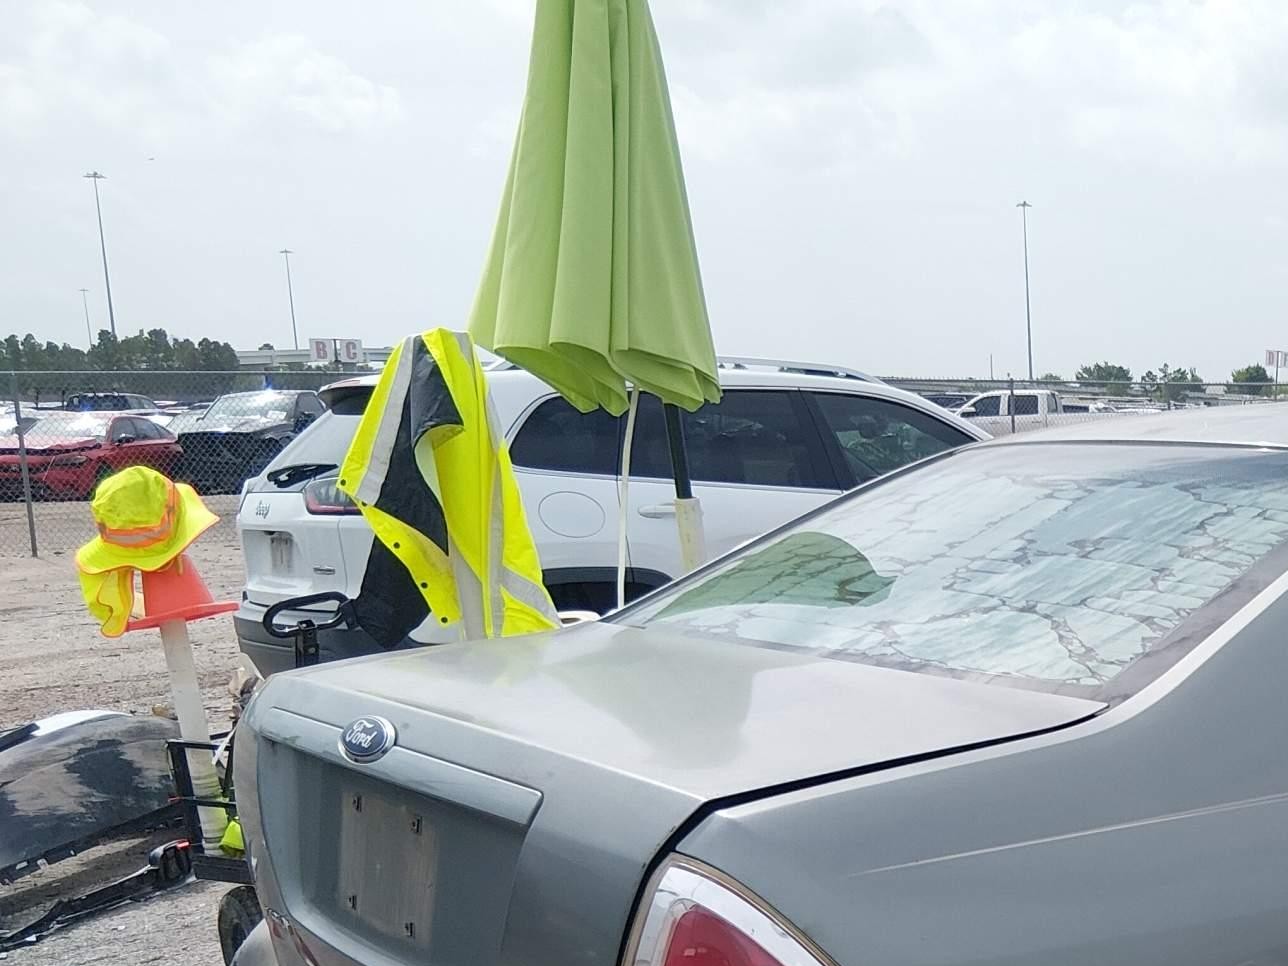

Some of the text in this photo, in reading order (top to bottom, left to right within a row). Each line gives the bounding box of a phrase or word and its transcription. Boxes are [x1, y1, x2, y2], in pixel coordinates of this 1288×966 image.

[315, 341, 328, 360] B
[345, 341, 358, 360] C
[345, 719, 378, 749] Ford
